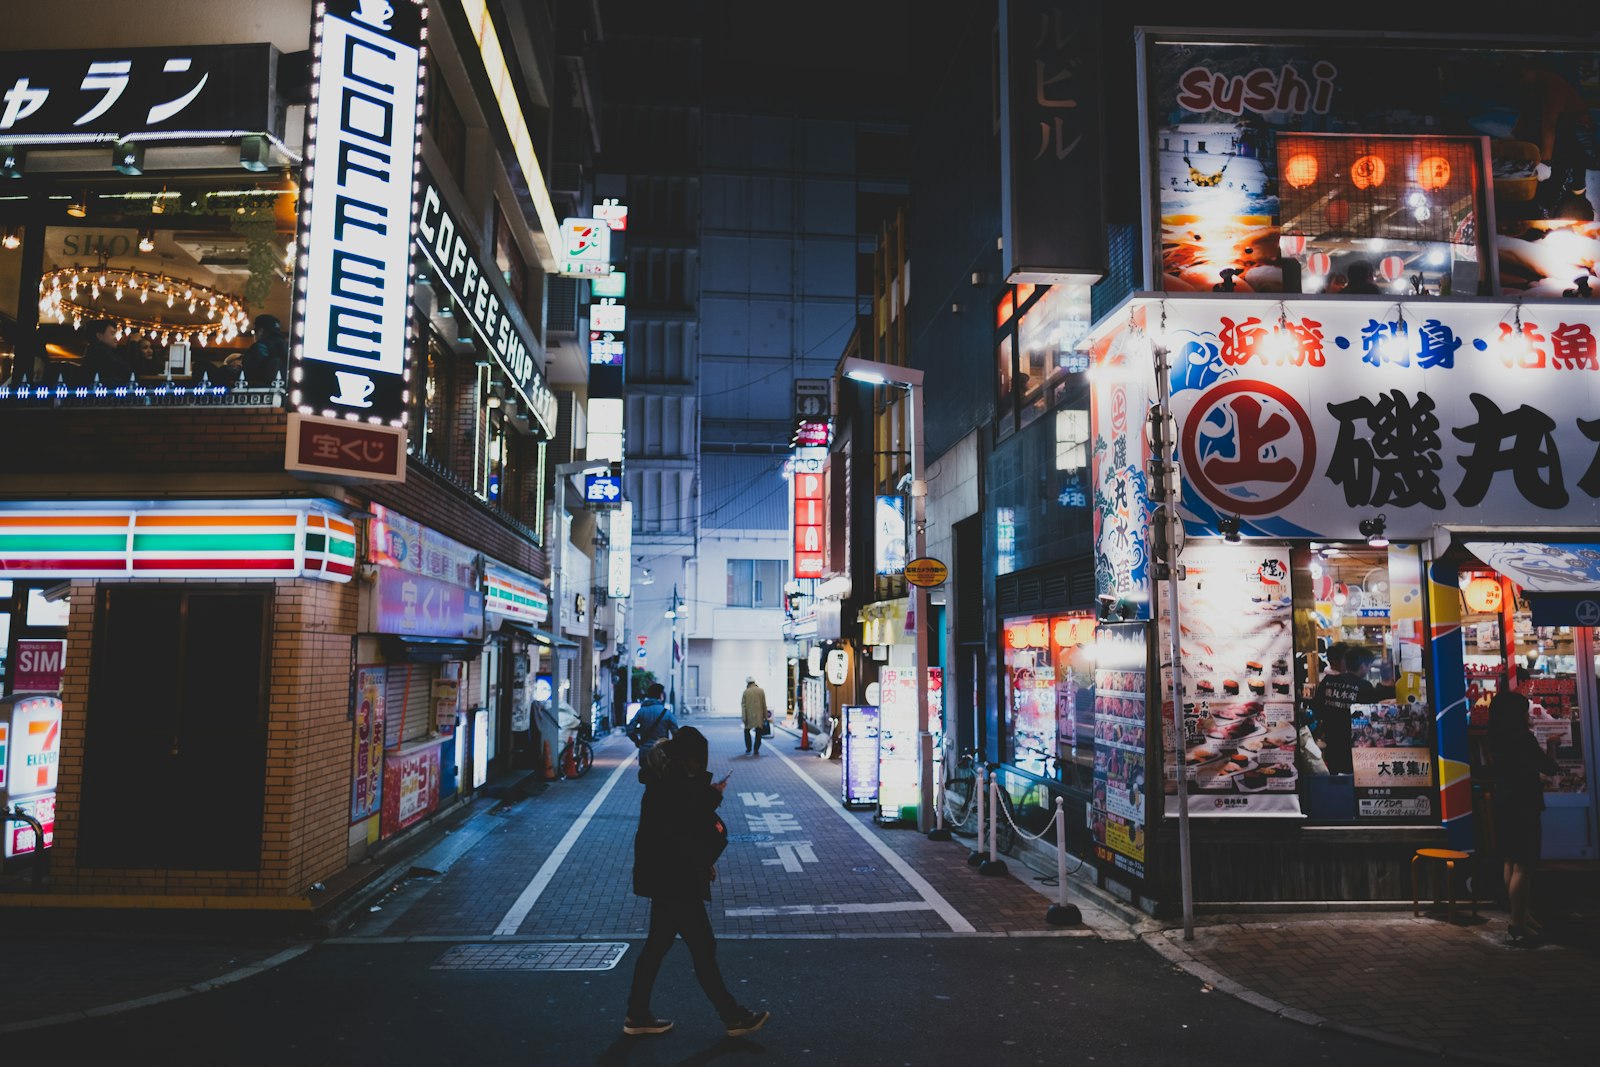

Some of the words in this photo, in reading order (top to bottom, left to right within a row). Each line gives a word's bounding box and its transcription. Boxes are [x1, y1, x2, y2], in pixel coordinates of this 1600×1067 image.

[1177, 60, 1338, 117] sushi
[326, 33, 397, 362] COFFEE
[419, 184, 500, 338] COFFEE
[497, 314, 533, 389] SHOP
[312, 434, 385, 464] 宝くじ
[804, 475, 819, 552] PIA
[1113, 434, 1130, 594] 磯丸水産
[18, 651, 60, 672] SIM
[881, 670, 897, 704] 焼肉
[1377, 760, 1430, 777] 大募集!!
